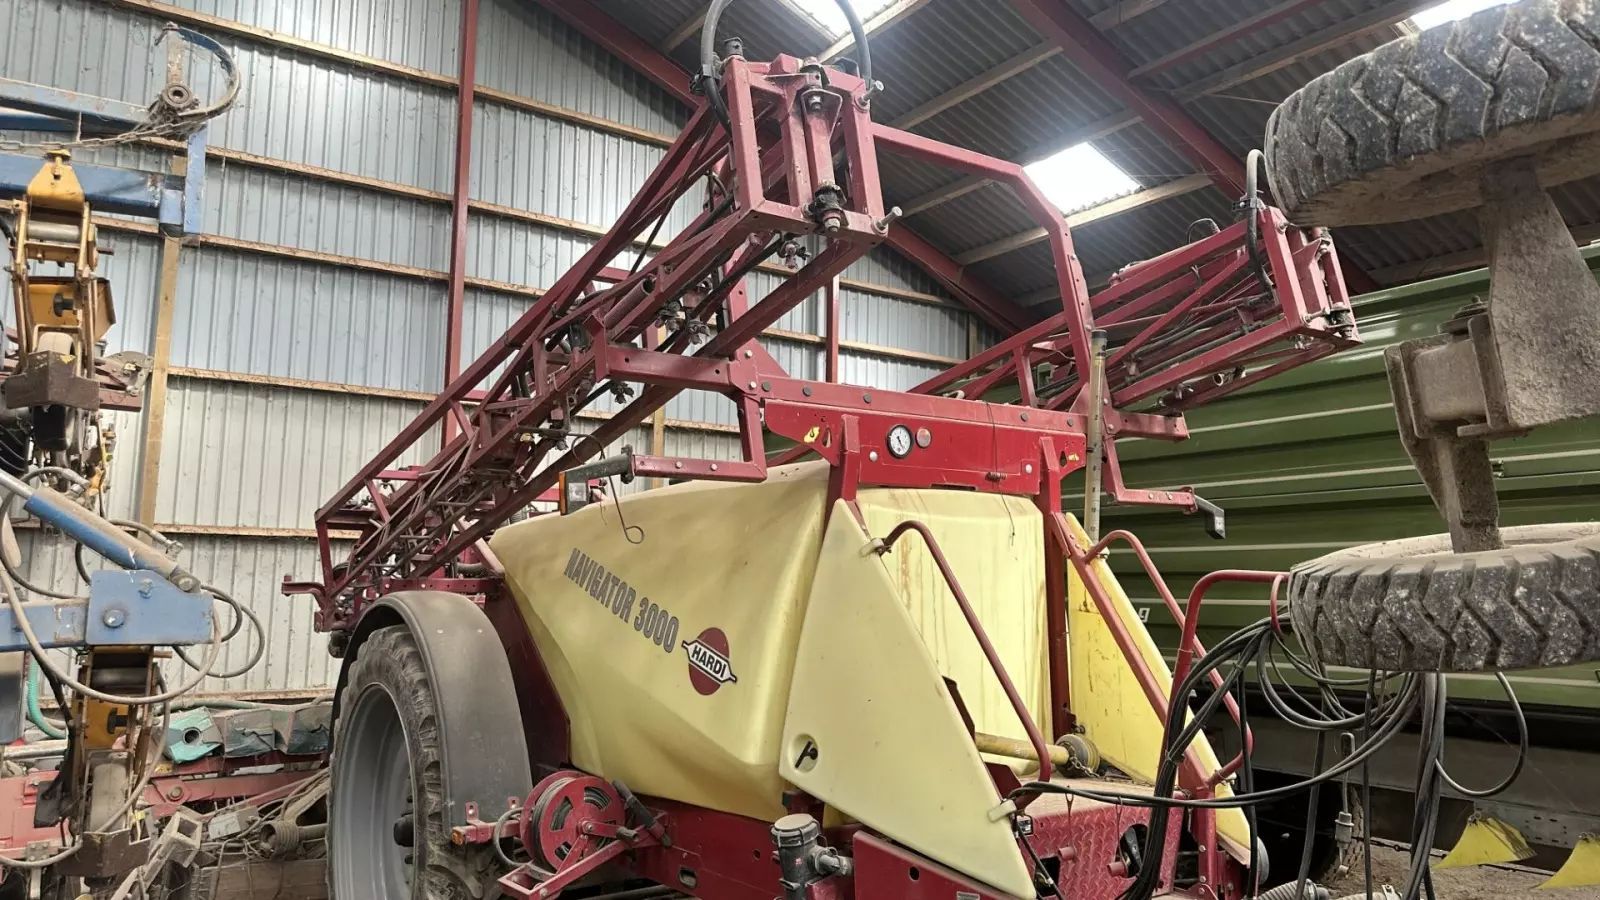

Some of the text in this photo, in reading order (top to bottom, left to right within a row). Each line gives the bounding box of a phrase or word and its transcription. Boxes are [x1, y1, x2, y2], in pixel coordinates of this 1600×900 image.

[563, 547, 680, 654] NAVIGATOR 3000
[691, 644, 727, 678] HARDI
